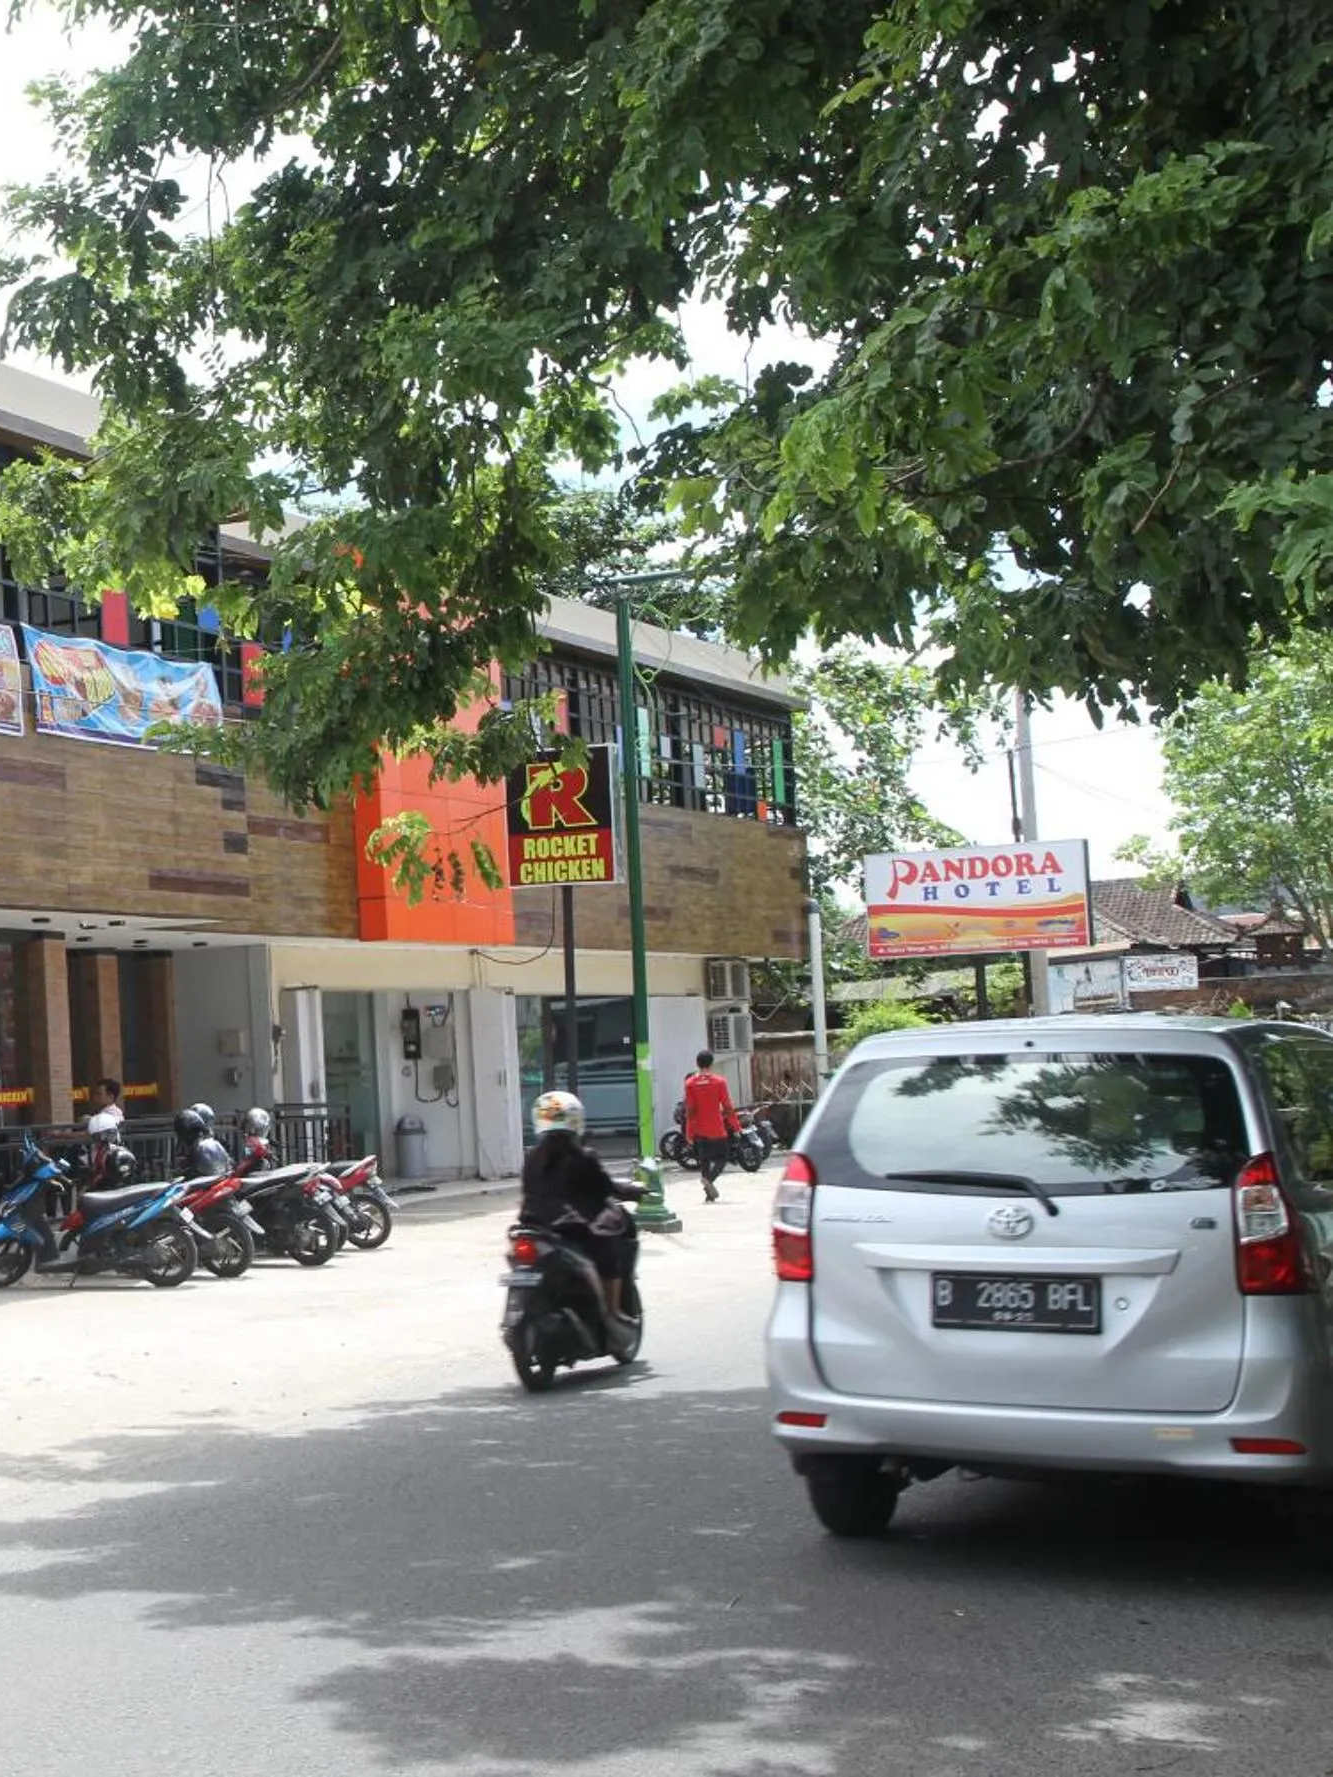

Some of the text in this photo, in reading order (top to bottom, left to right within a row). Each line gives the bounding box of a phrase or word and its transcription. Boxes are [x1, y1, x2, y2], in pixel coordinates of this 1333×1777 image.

[523, 833, 598, 860] ROCKET
[520, 858, 606, 884] CHICKEN
[886, 851, 1064, 900] PANDORA
[922, 877, 1062, 902] HOTEL
[935, 1279, 1093, 1311] B 2865 BFL
